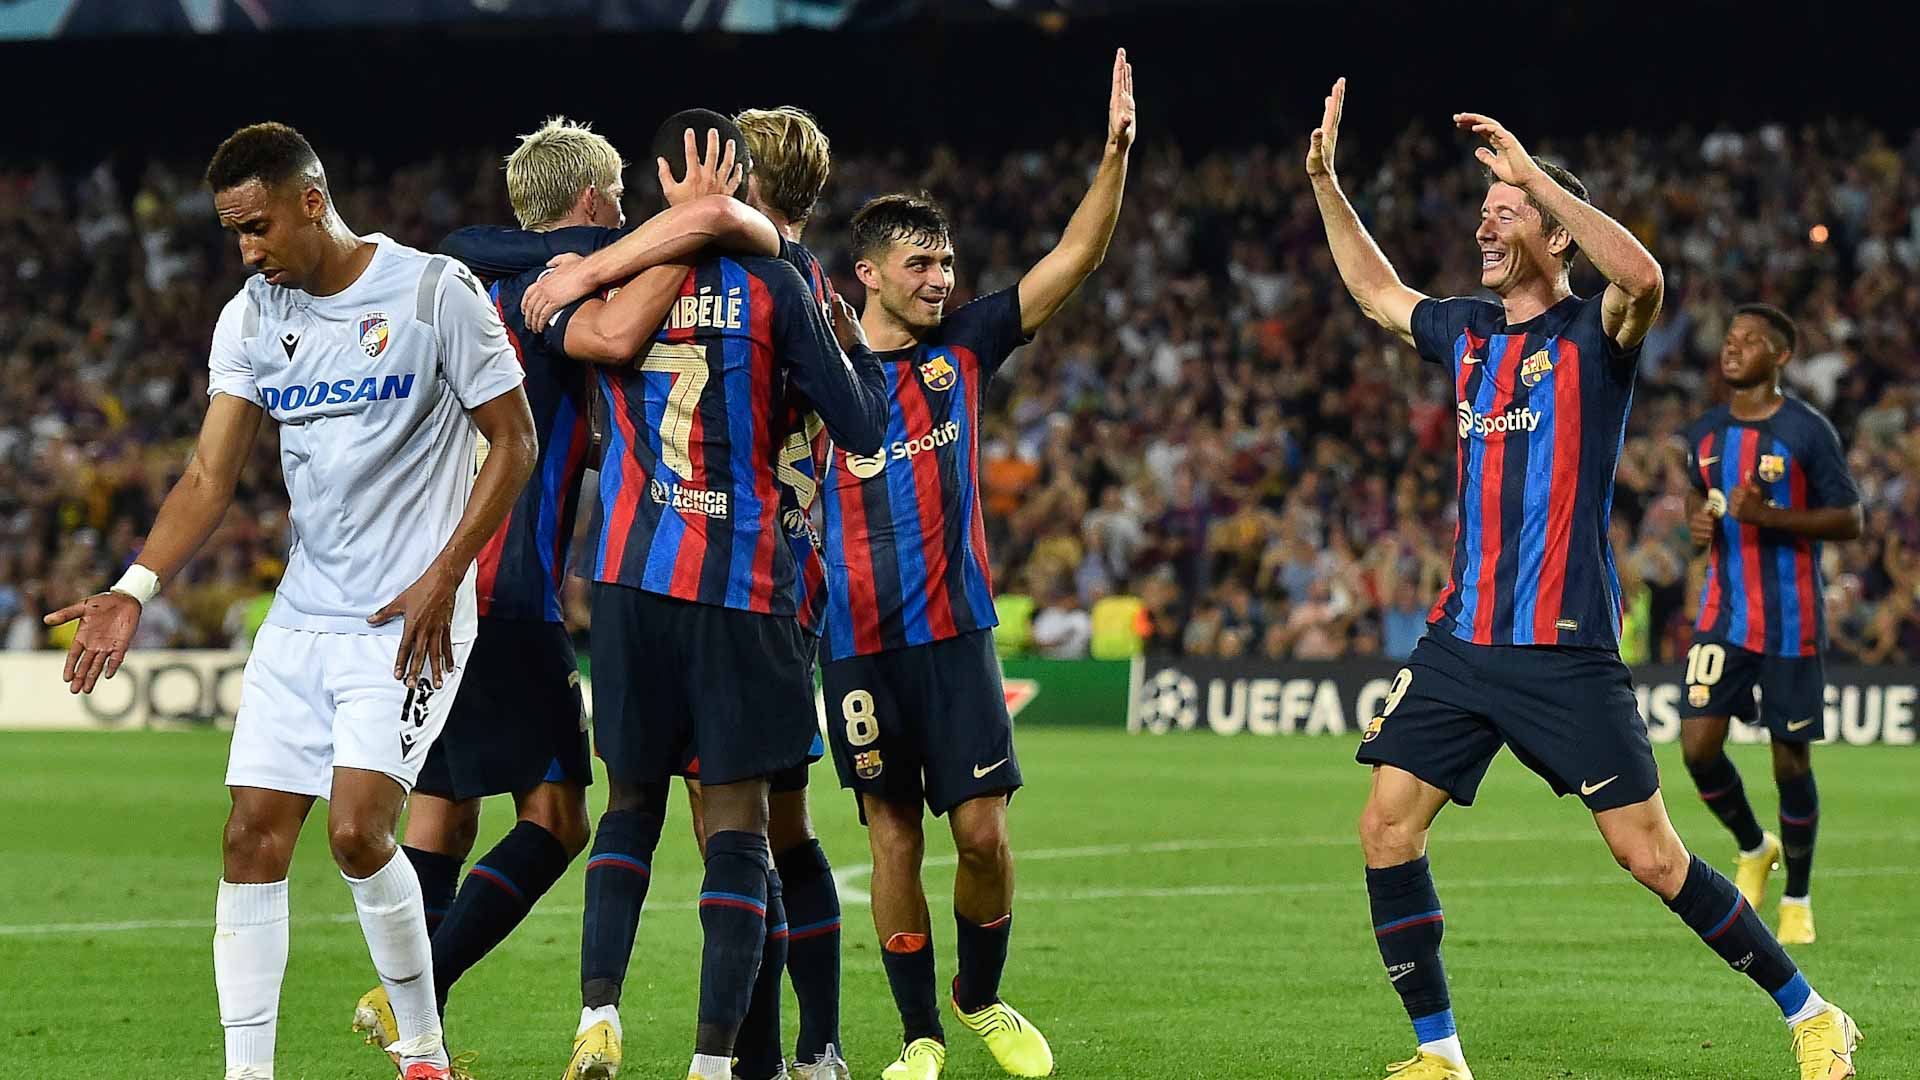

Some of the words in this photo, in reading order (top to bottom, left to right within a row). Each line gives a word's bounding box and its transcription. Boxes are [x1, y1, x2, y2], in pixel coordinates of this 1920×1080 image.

[262, 373, 416, 411] DOOSAN
[640, 342, 710, 482] 7
[890, 420, 960, 461] Spotify
[1474, 407, 1542, 437] Spotify
[672, 483, 728, 505] UNHCR
[672, 494, 728, 515] ACNUR
[1685, 643, 1726, 686] 10
[841, 689, 880, 747] 8
[1206, 678, 1348, 736] UEFA
